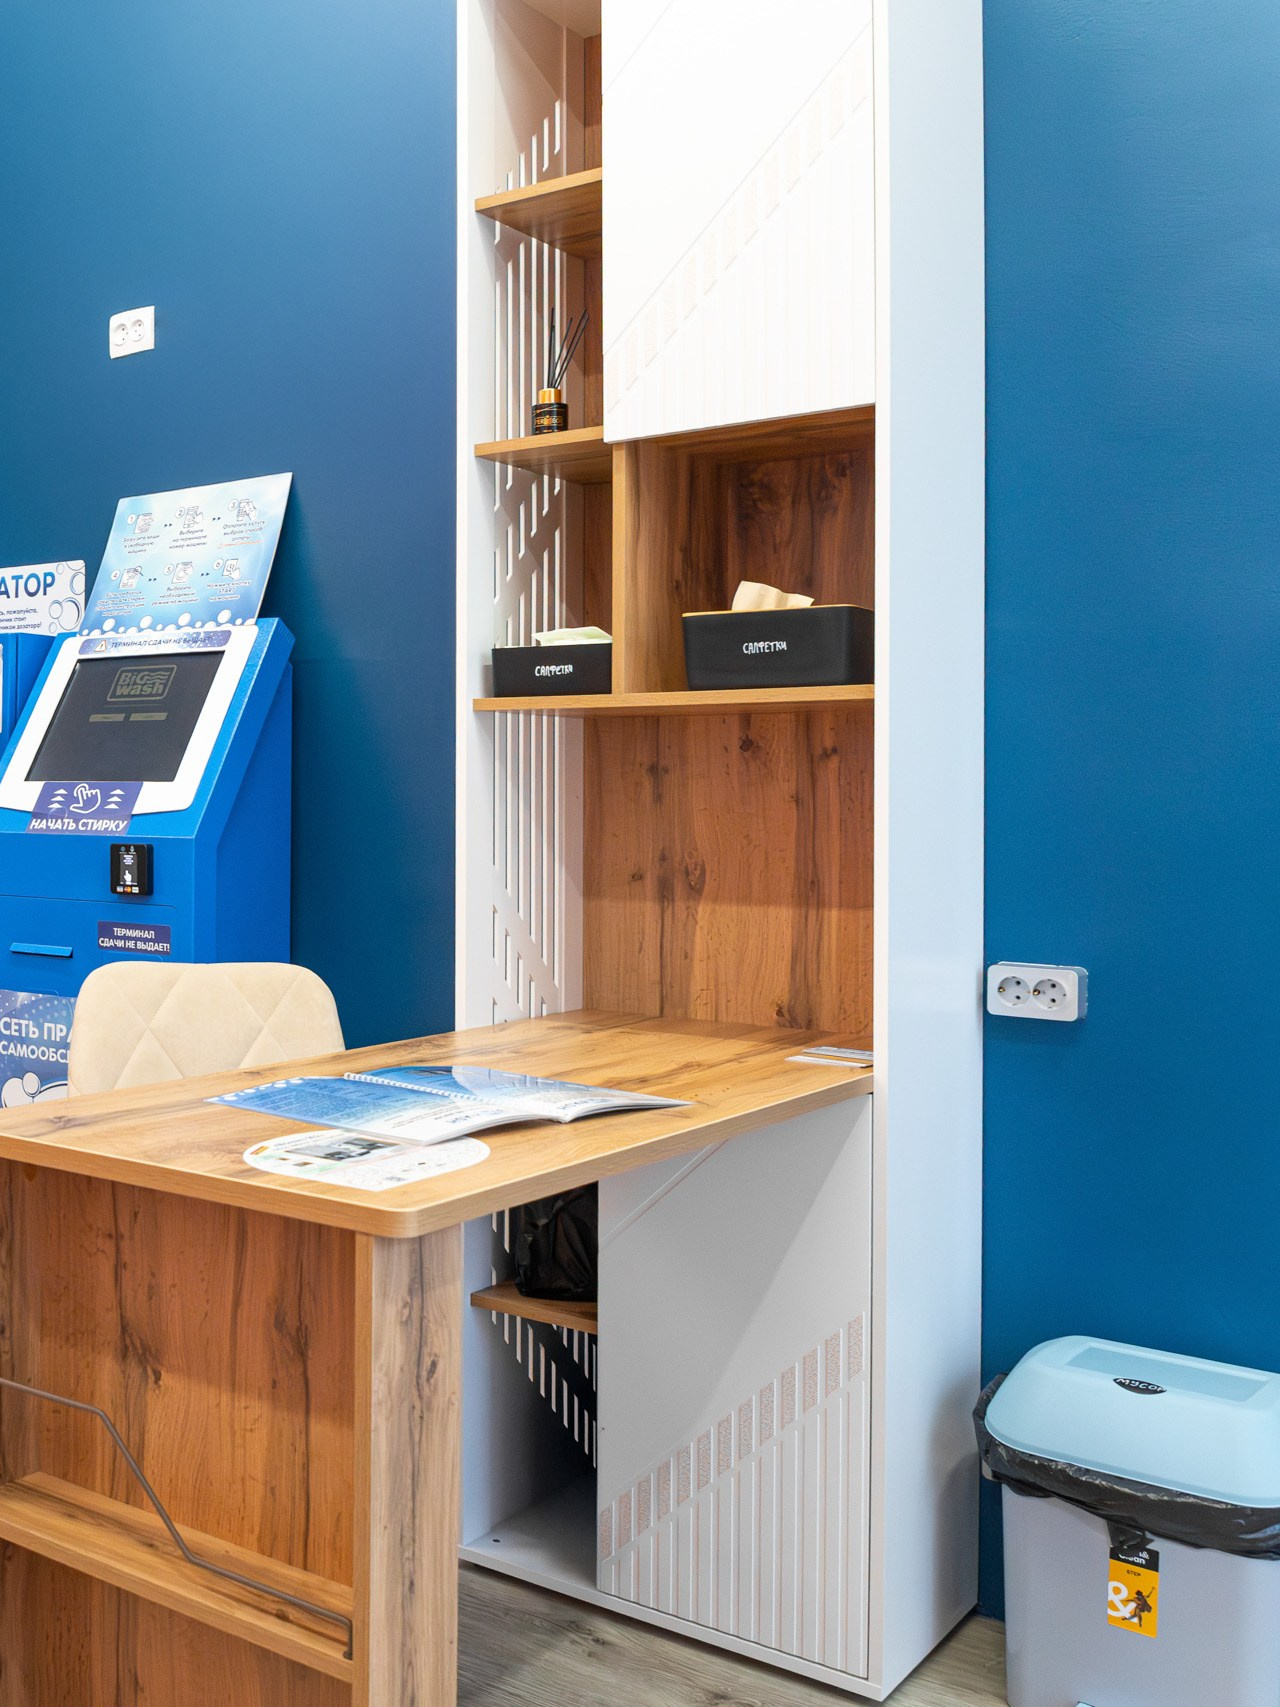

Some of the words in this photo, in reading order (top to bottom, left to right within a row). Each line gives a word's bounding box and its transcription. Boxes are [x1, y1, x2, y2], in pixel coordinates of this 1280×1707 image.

[29, 818, 76, 830] НАЧАТЬ
[79, 819, 127, 831] СТИРКУ
[113, 927, 155, 939] ТЕРМИНАЛ
[99, 938, 125, 947] СДАЧИ
[125, 940, 136, 949] НЕ
[136, 941, 170, 952] ВЫДАЕТ!
[0, 1016, 39, 1038] СЕТЬ
